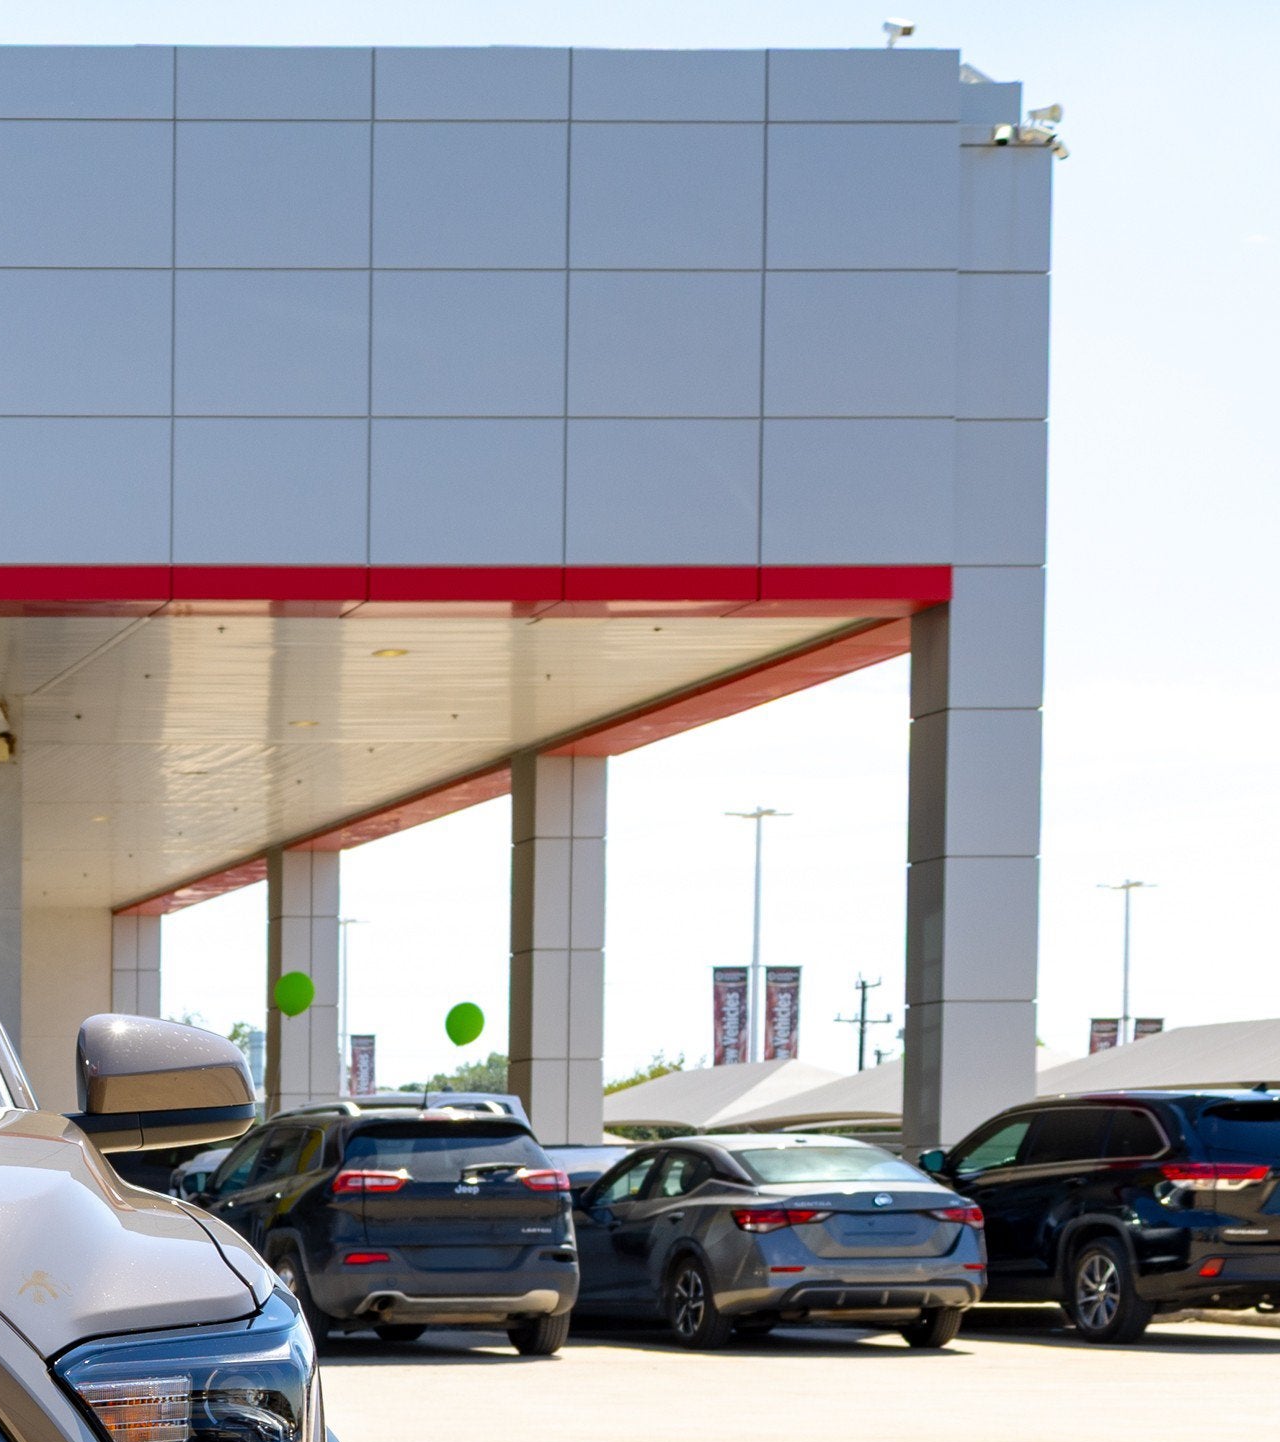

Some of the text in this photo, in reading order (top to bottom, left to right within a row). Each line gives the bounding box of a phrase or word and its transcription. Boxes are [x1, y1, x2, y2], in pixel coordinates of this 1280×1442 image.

[721, 991, 740, 1046] Vehicles
[773, 991, 791, 1046] Vehicles
[454, 1184, 480, 1195] Jeep
